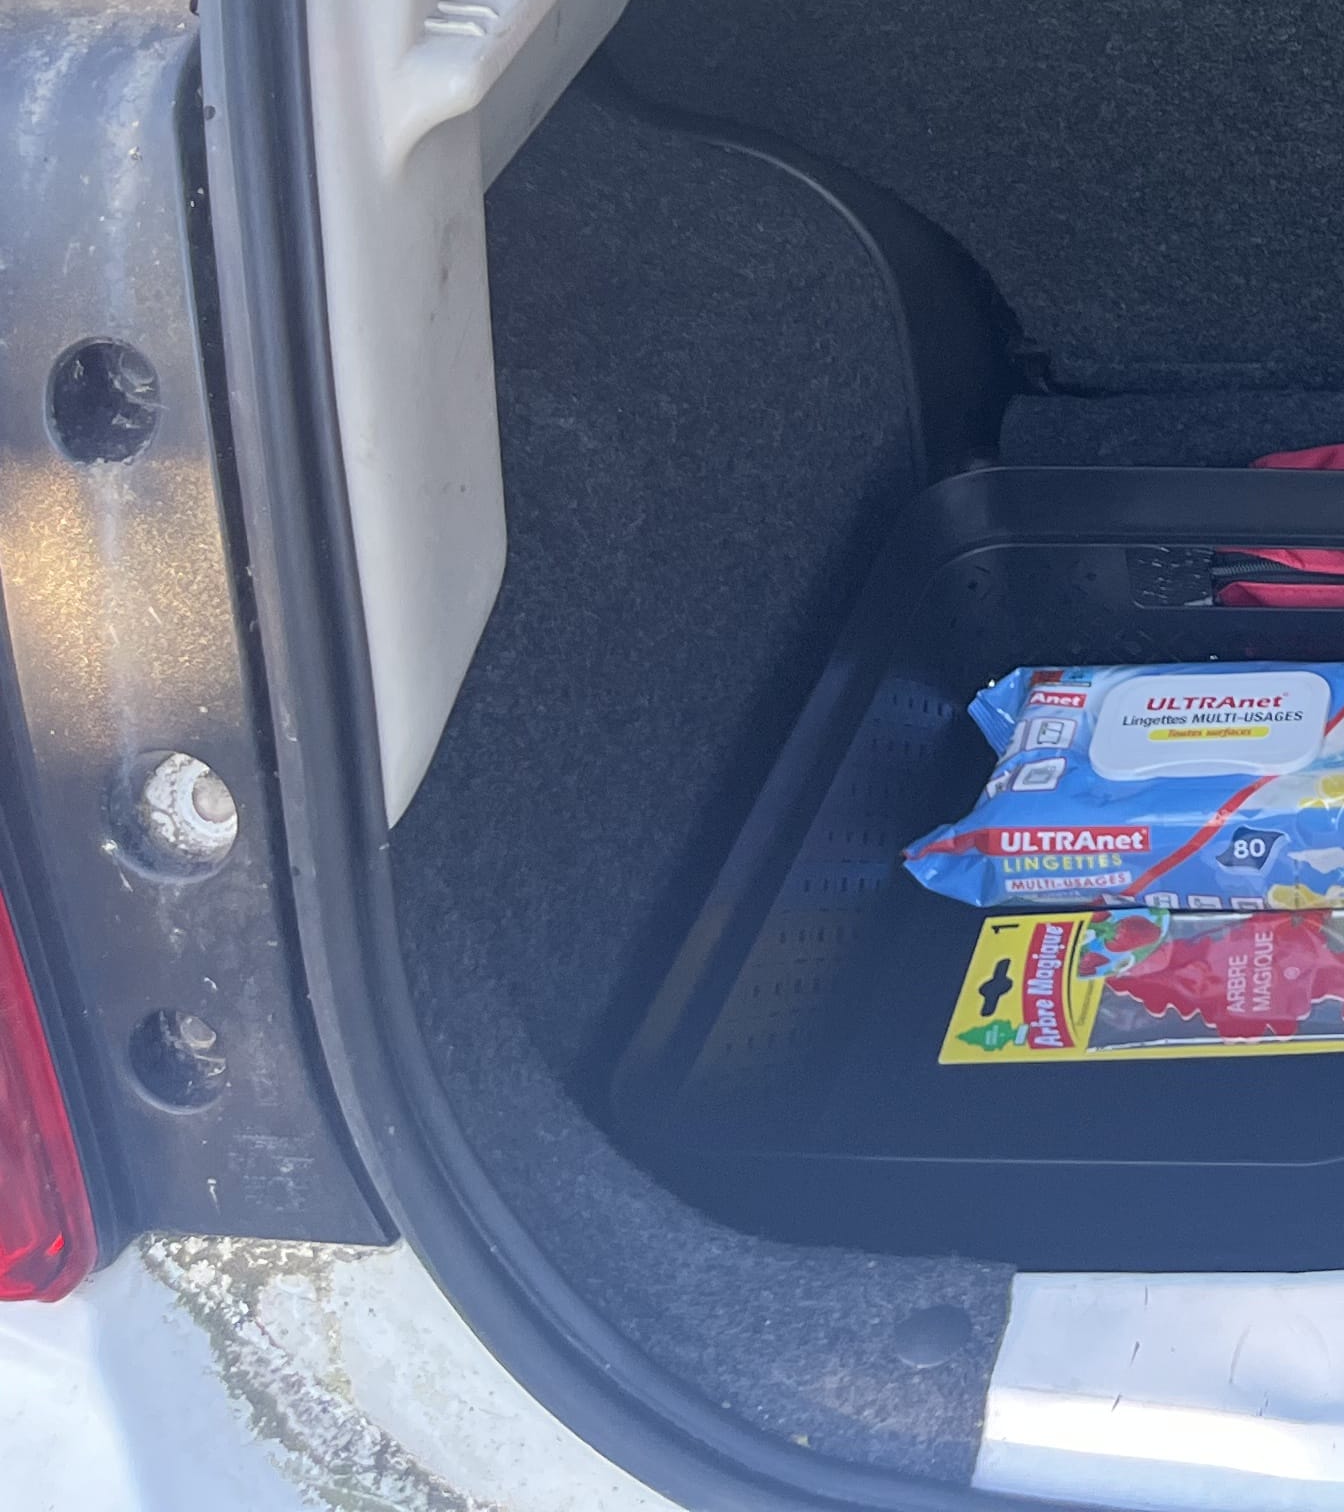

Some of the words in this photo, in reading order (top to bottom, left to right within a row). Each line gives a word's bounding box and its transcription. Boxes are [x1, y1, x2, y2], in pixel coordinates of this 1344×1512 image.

[1147, 693, 1283, 710] ULTRAnet
[1122, 714, 1187, 728] Lingettes
[1191, 710, 1304, 724] MULTI-USAGES
[1000, 830, 1144, 853] ULTRAnet
[1233, 838, 1266, 859] 80
[1003, 852, 1123, 873] LINGETTES
[1010, 872, 1127, 891] MULTI-USAGES
[991, 923, 1020, 934] 1
[1026, 922, 1066, 996] Magique
[1252, 931, 1274, 1012] MAGIQUE
[1226, 954, 1248, 1013] ARBRE
[1029, 999, 1064, 1047] Arbre
